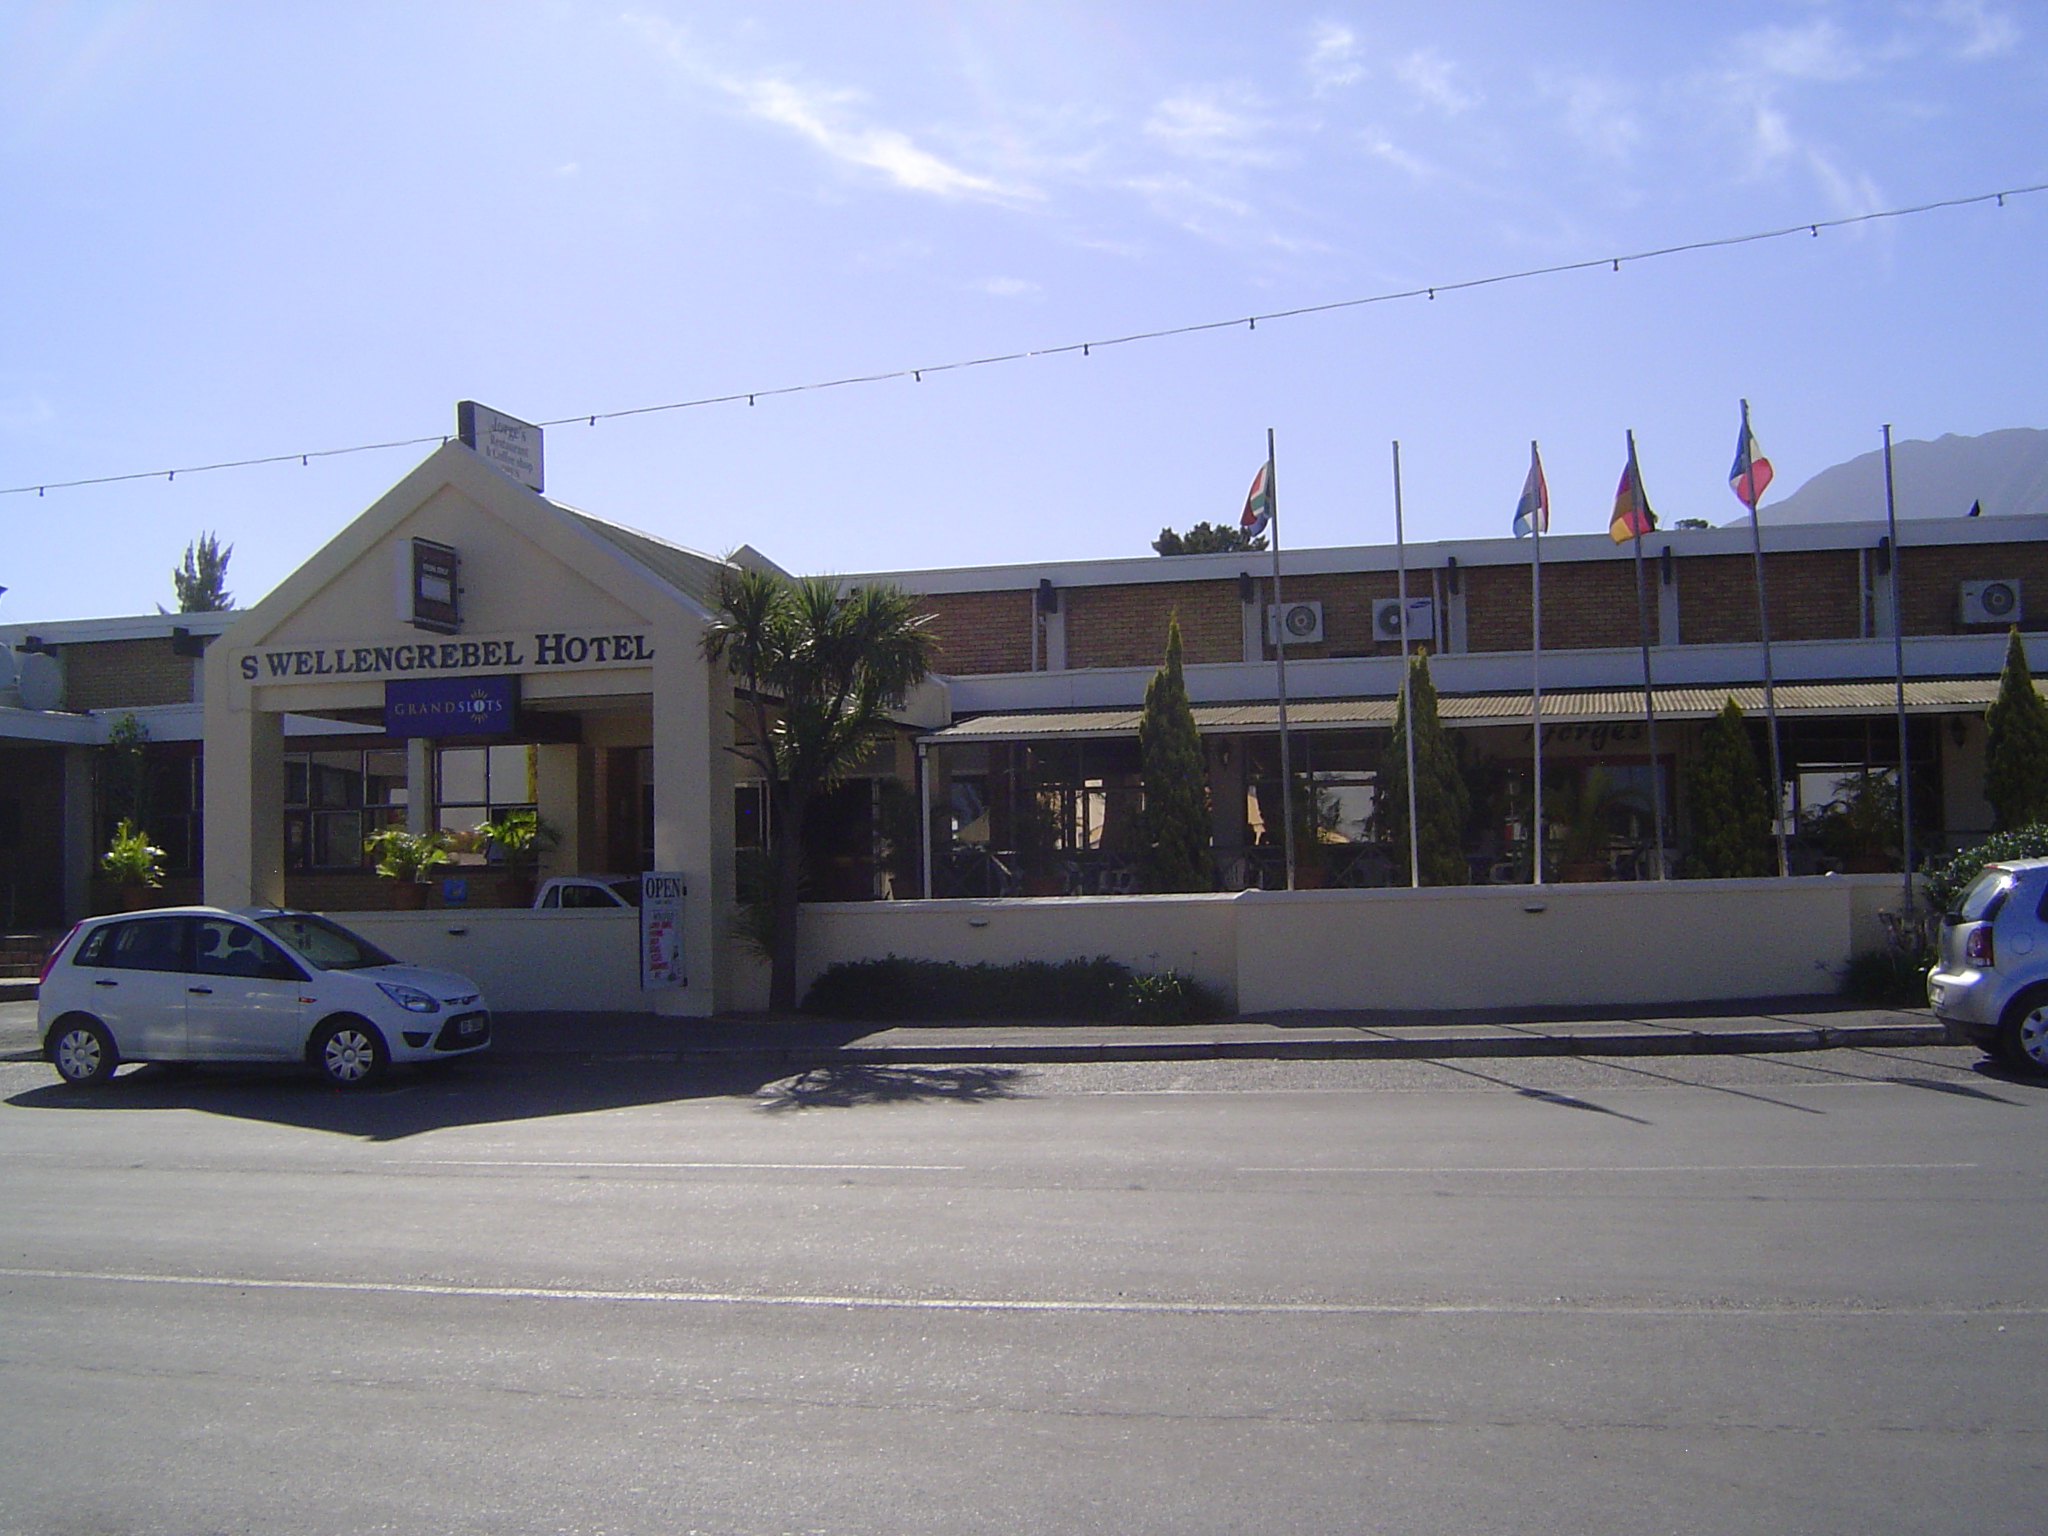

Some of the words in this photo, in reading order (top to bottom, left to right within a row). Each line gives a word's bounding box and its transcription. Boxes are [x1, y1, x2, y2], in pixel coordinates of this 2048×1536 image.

[240, 641, 524, 680] SWELLENGREBEL
[534, 633, 655, 666] HOTEL
[645, 877, 681, 899] OPEN
